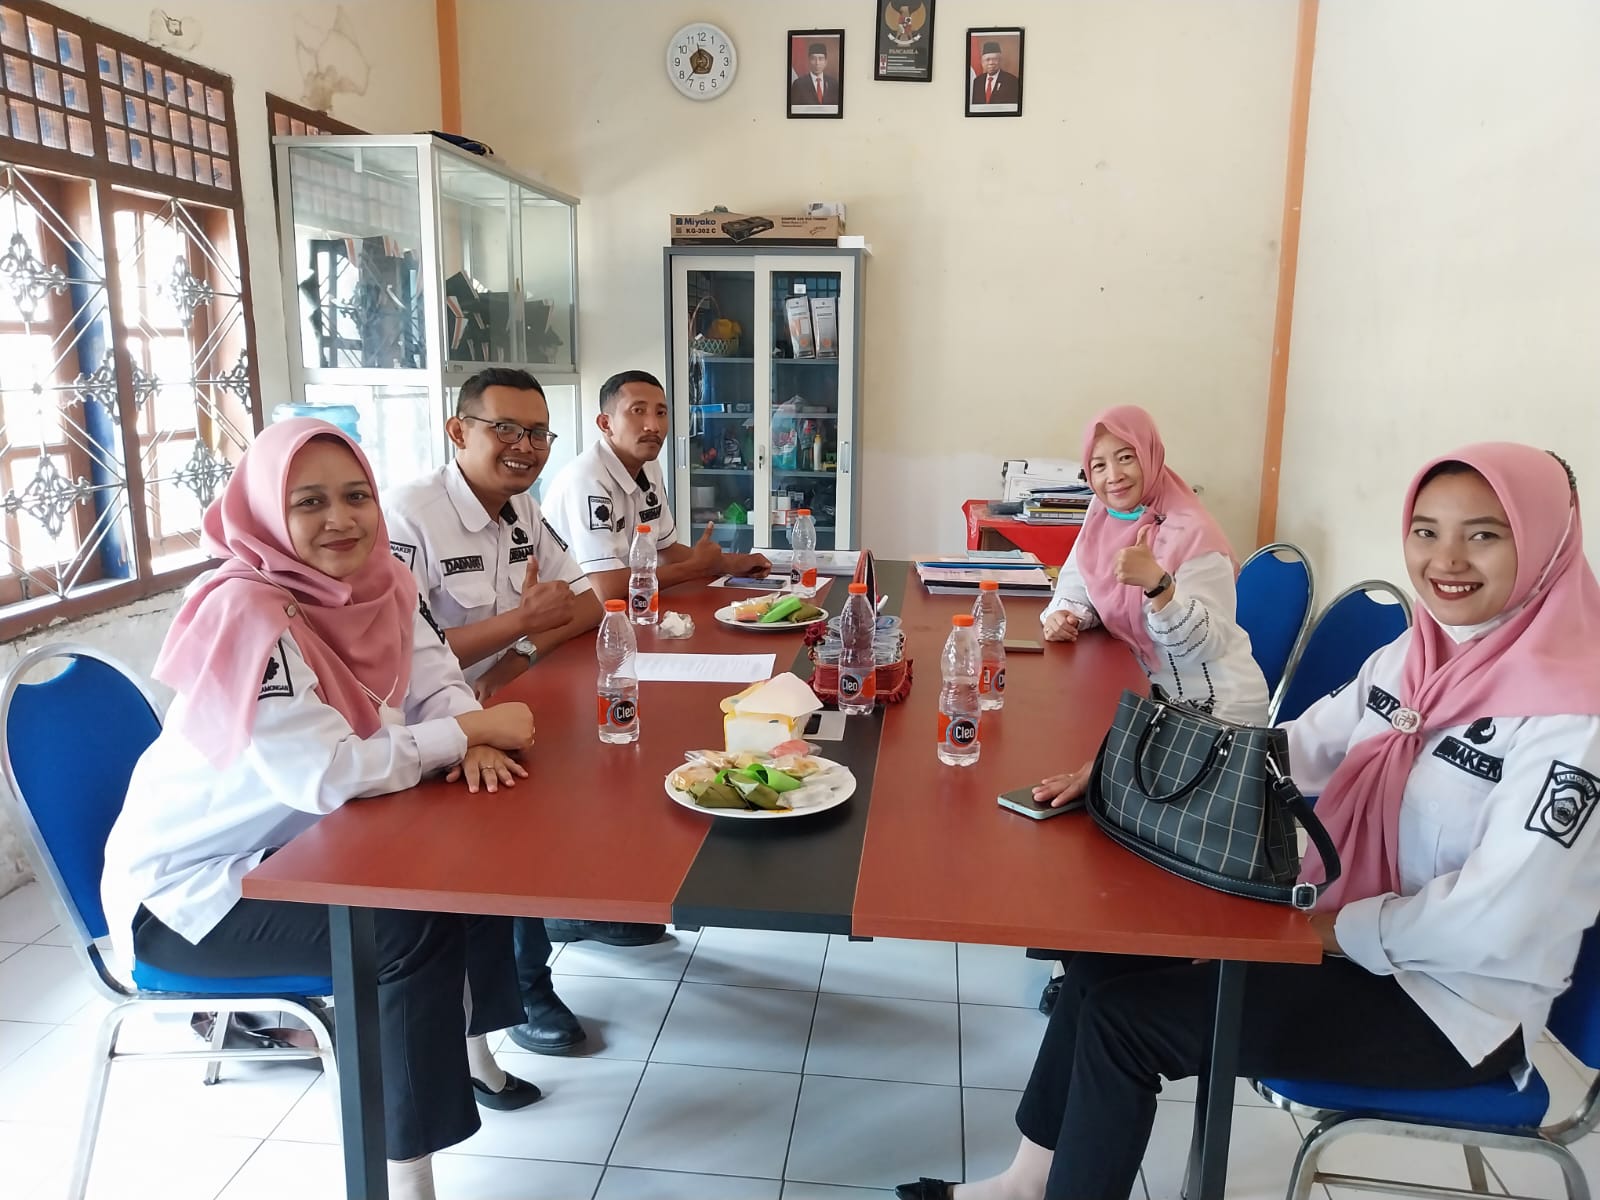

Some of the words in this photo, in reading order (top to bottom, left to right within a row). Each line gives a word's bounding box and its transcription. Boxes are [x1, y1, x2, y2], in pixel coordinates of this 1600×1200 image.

[687, 35, 695, 45] 11
[697, 31, 706, 41] 12
[710, 35, 714, 45] 1
[678, 44, 687, 54] 10
[719, 44, 726, 53] 2
[674, 57, 680, 67] 9
[723, 56, 729, 66] 3
[679, 70, 685, 79] 8
[719, 70, 725, 79] 4
[687, 78, 694, 88] 7
[699, 81, 705, 91] 6
[711, 78, 717, 88] 5
[684, 217, 717, 227] Miyako
[616, 706, 635, 719] Cleo
[955, 726, 975, 739] Cleo
